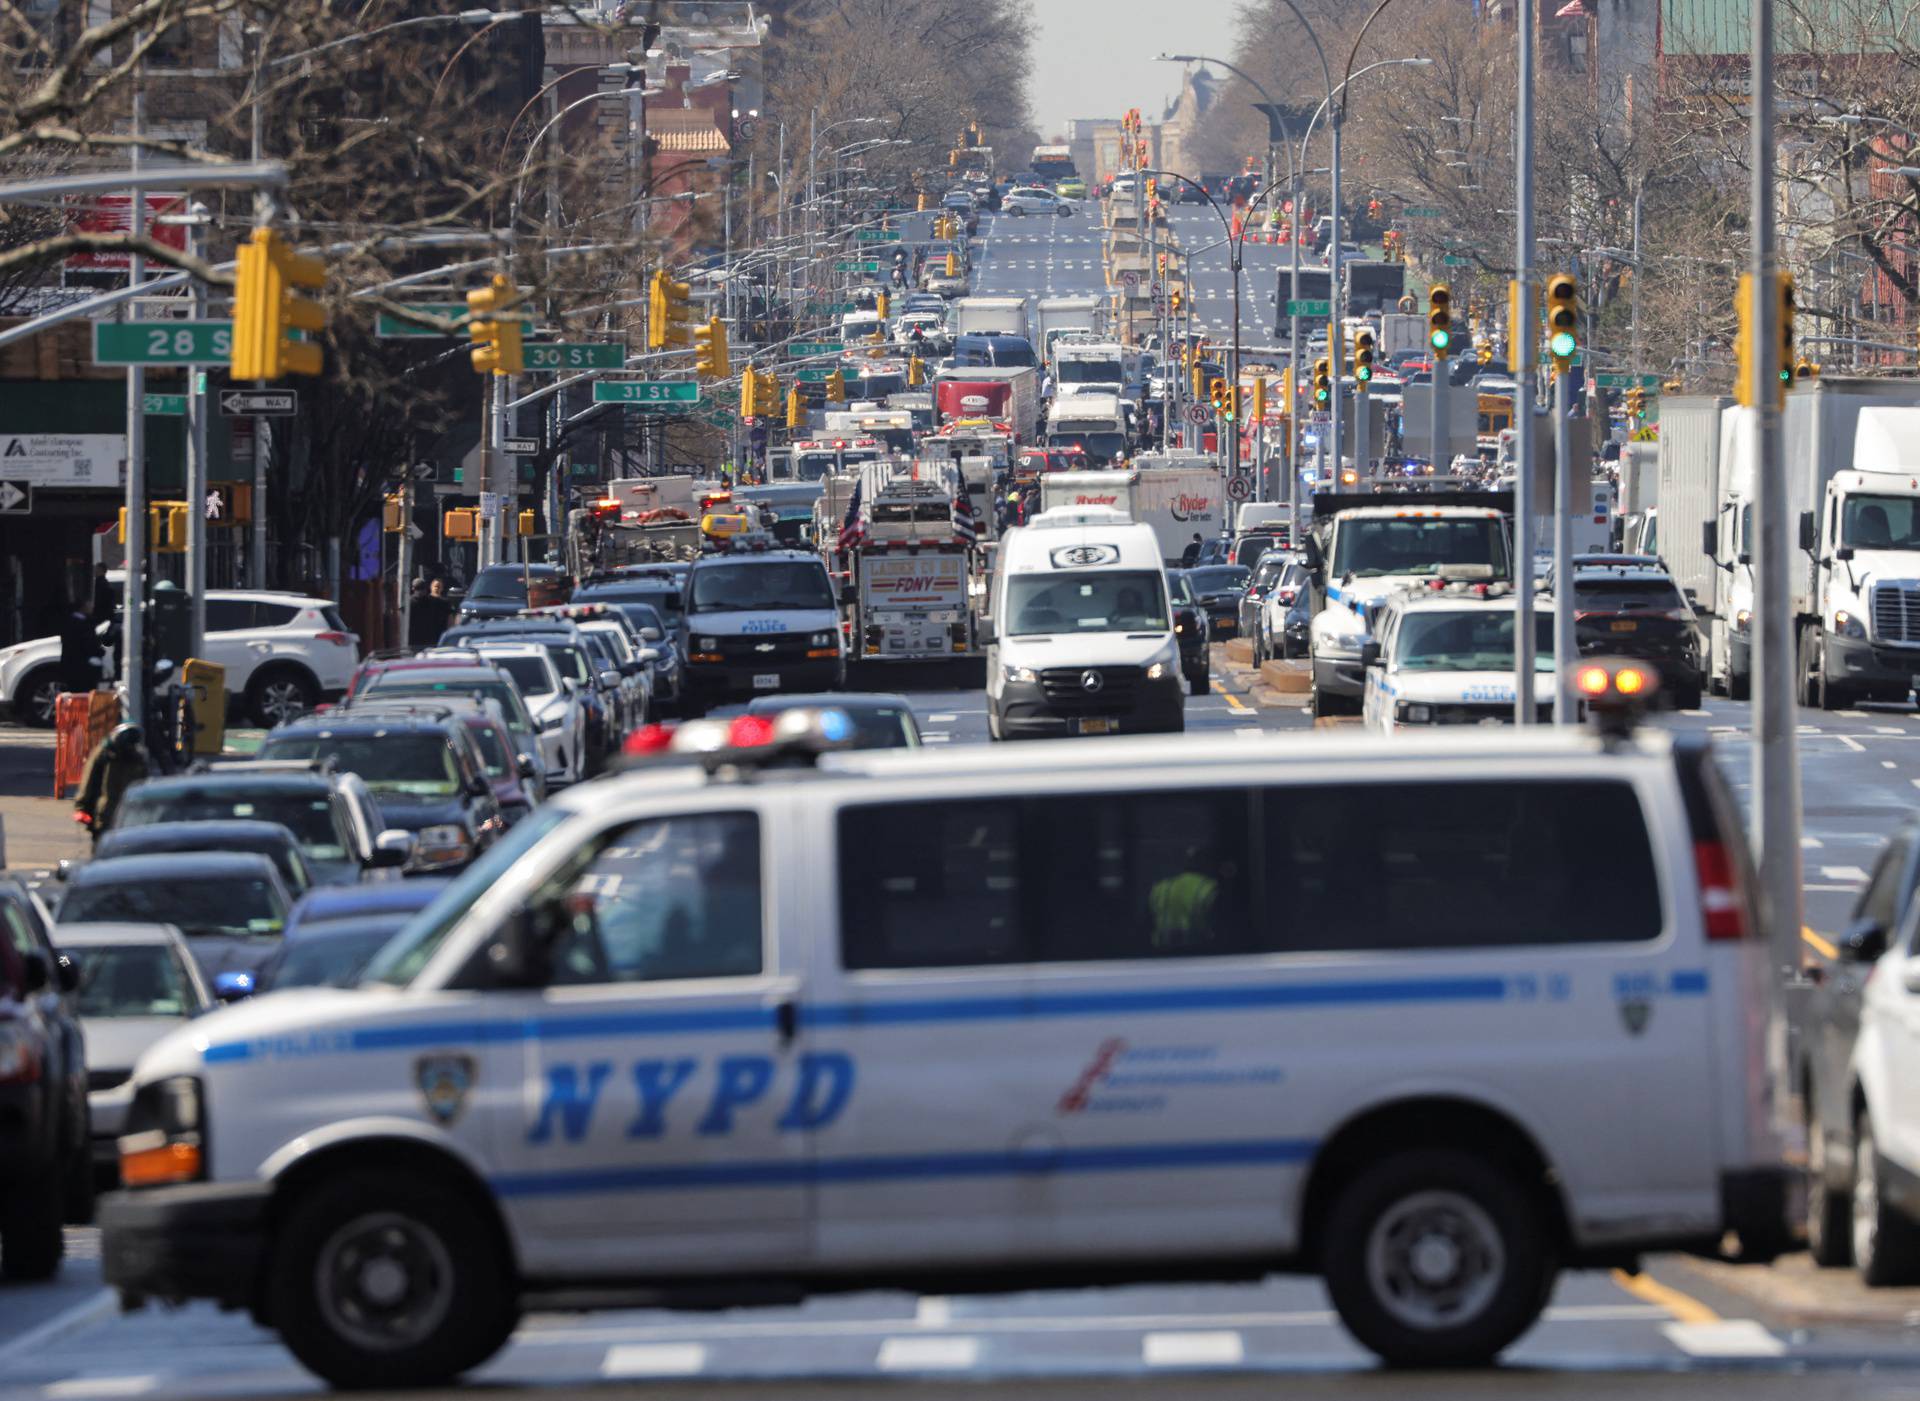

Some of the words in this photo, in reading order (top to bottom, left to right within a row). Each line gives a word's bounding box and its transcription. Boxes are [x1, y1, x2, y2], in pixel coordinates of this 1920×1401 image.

[148, 331, 194, 355] 28
[212, 331, 231, 355] S
[533, 349, 560, 365] 30
[570, 349, 595, 365] St
[624, 386, 641, 398] 31
[650, 386, 670, 398] St
[144, 397, 162, 411] 29
[265, 399, 288, 408] WAY
[1180, 493, 1208, 515] Ryder
[896, 576, 934, 592] FDNY
[742, 624, 787, 632] POLICE
[525, 1052, 857, 1146] NYPD
